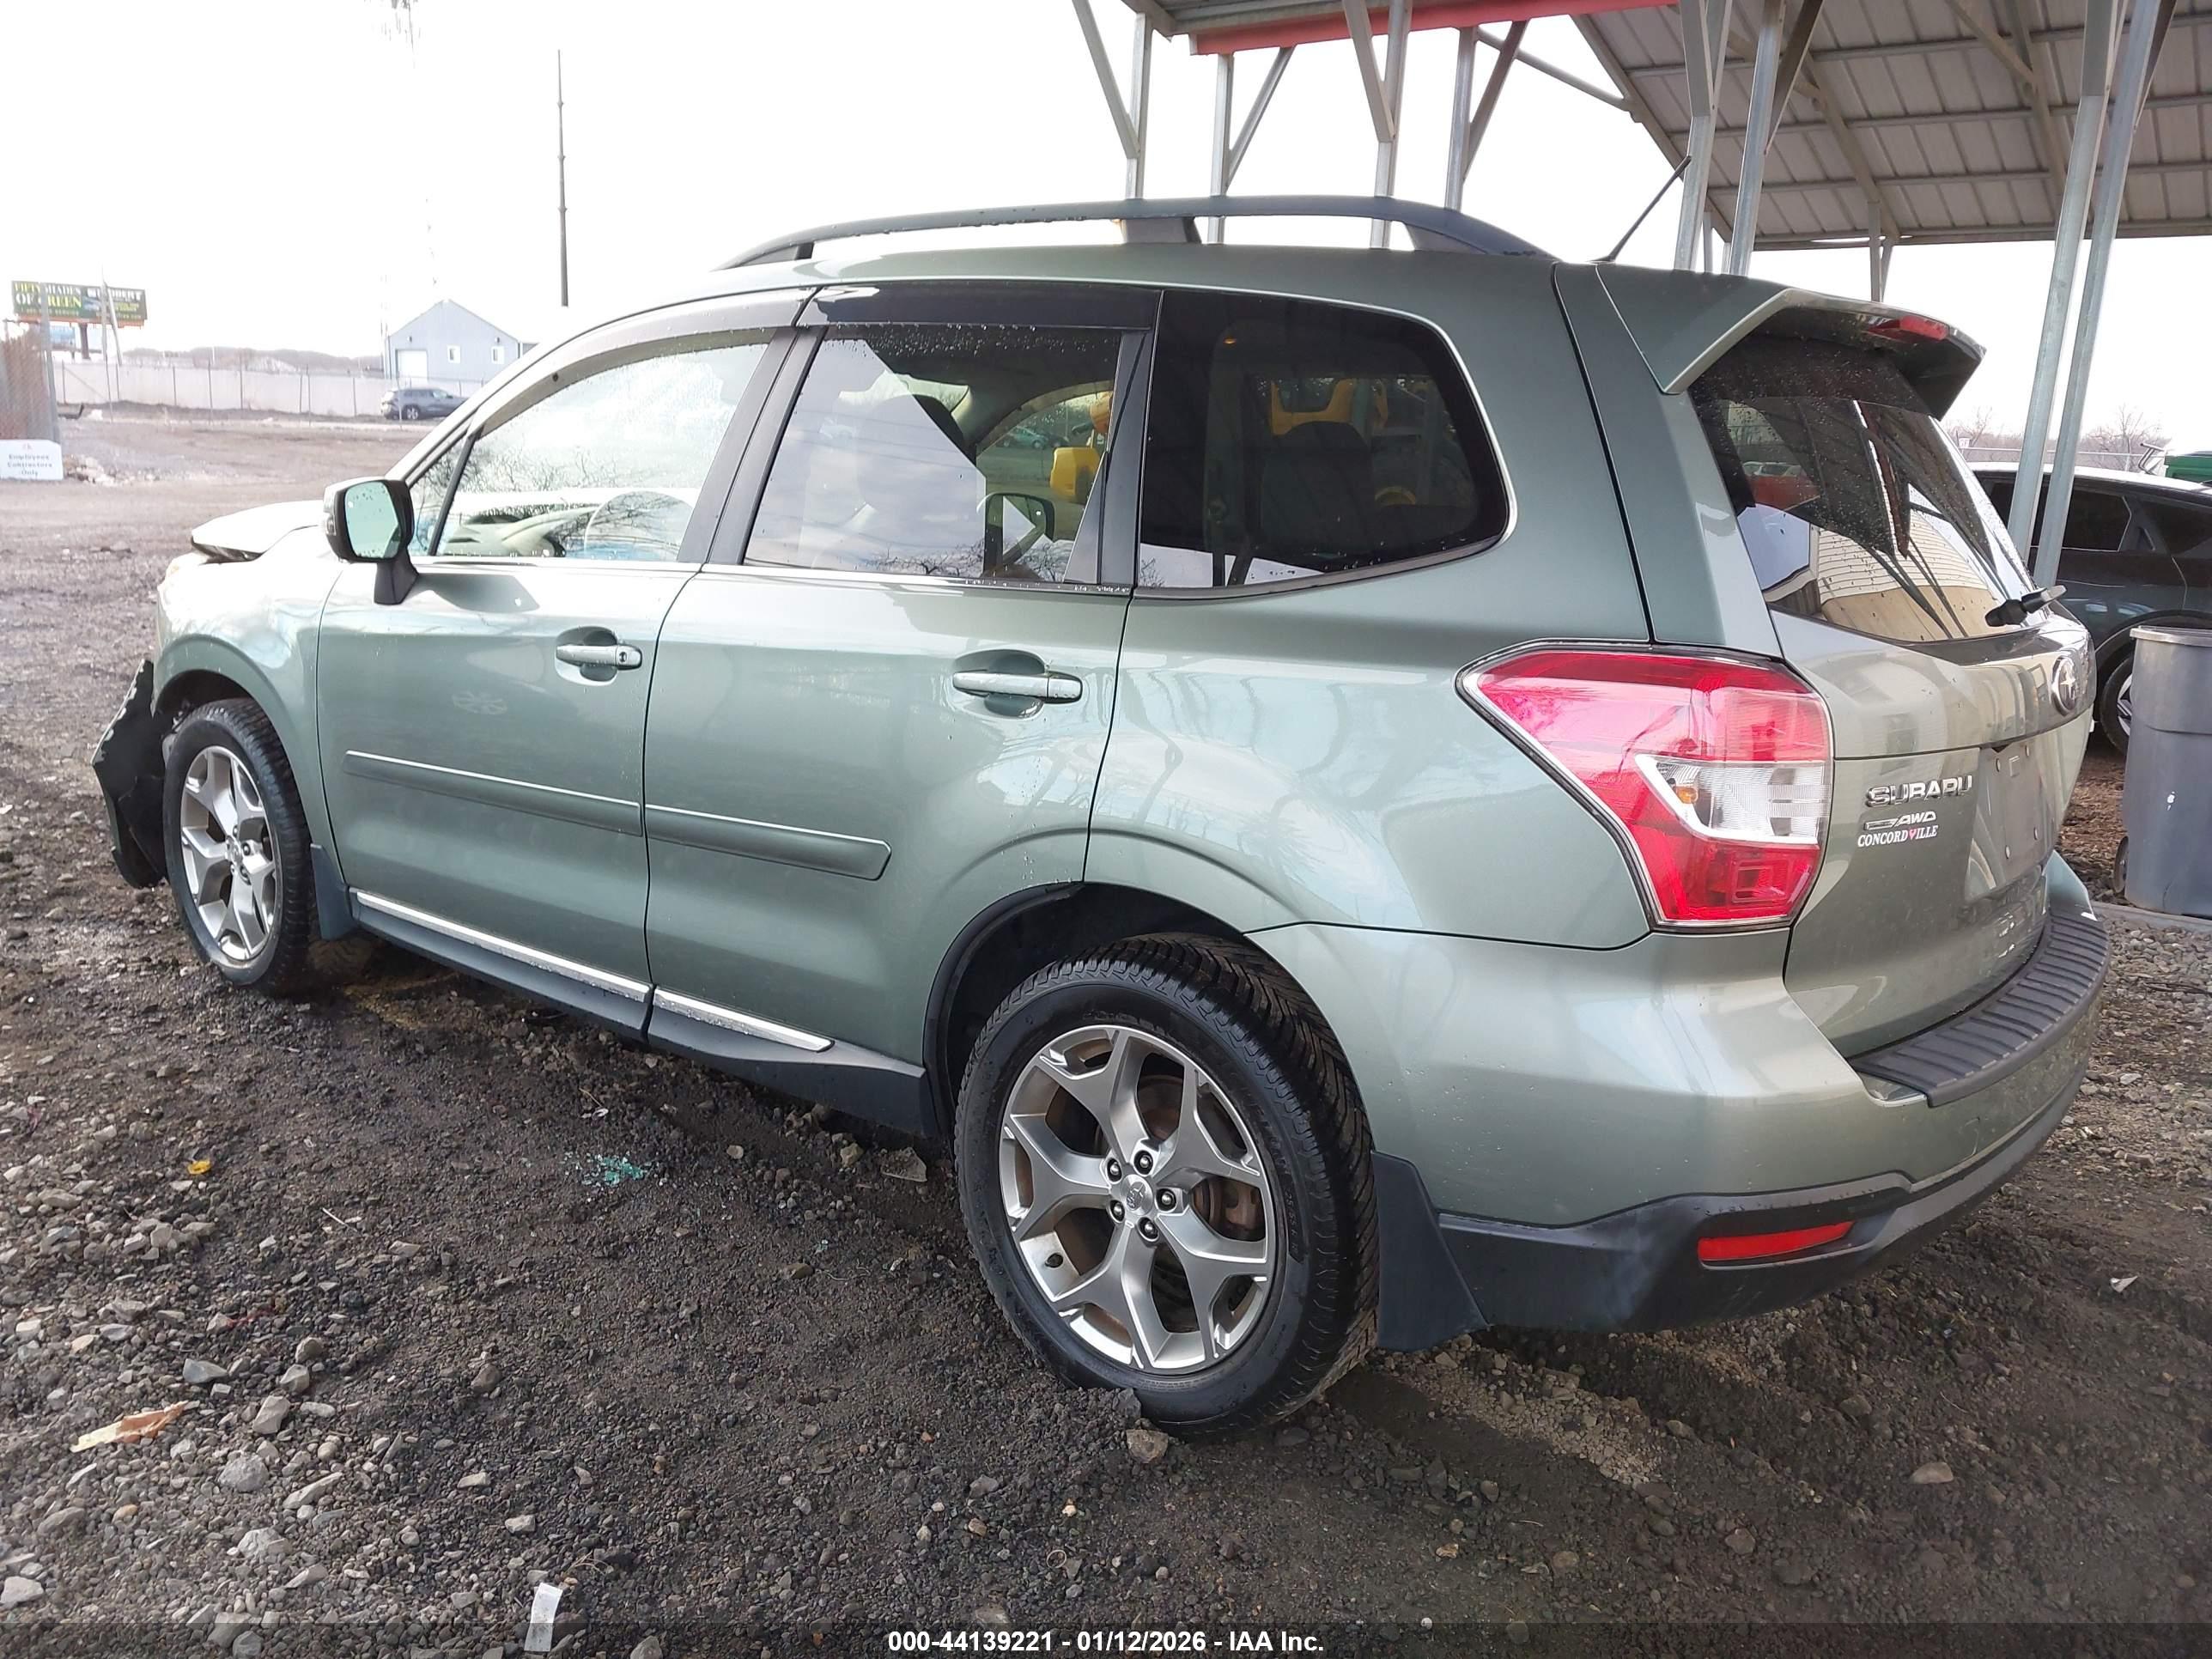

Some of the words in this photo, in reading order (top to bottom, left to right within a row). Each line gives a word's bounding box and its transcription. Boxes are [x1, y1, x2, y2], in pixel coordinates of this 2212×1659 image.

[15, 293, 34, 306] OF
[1865, 775, 1972, 807] SUBARU
[1893, 811, 1937, 828] AWD
